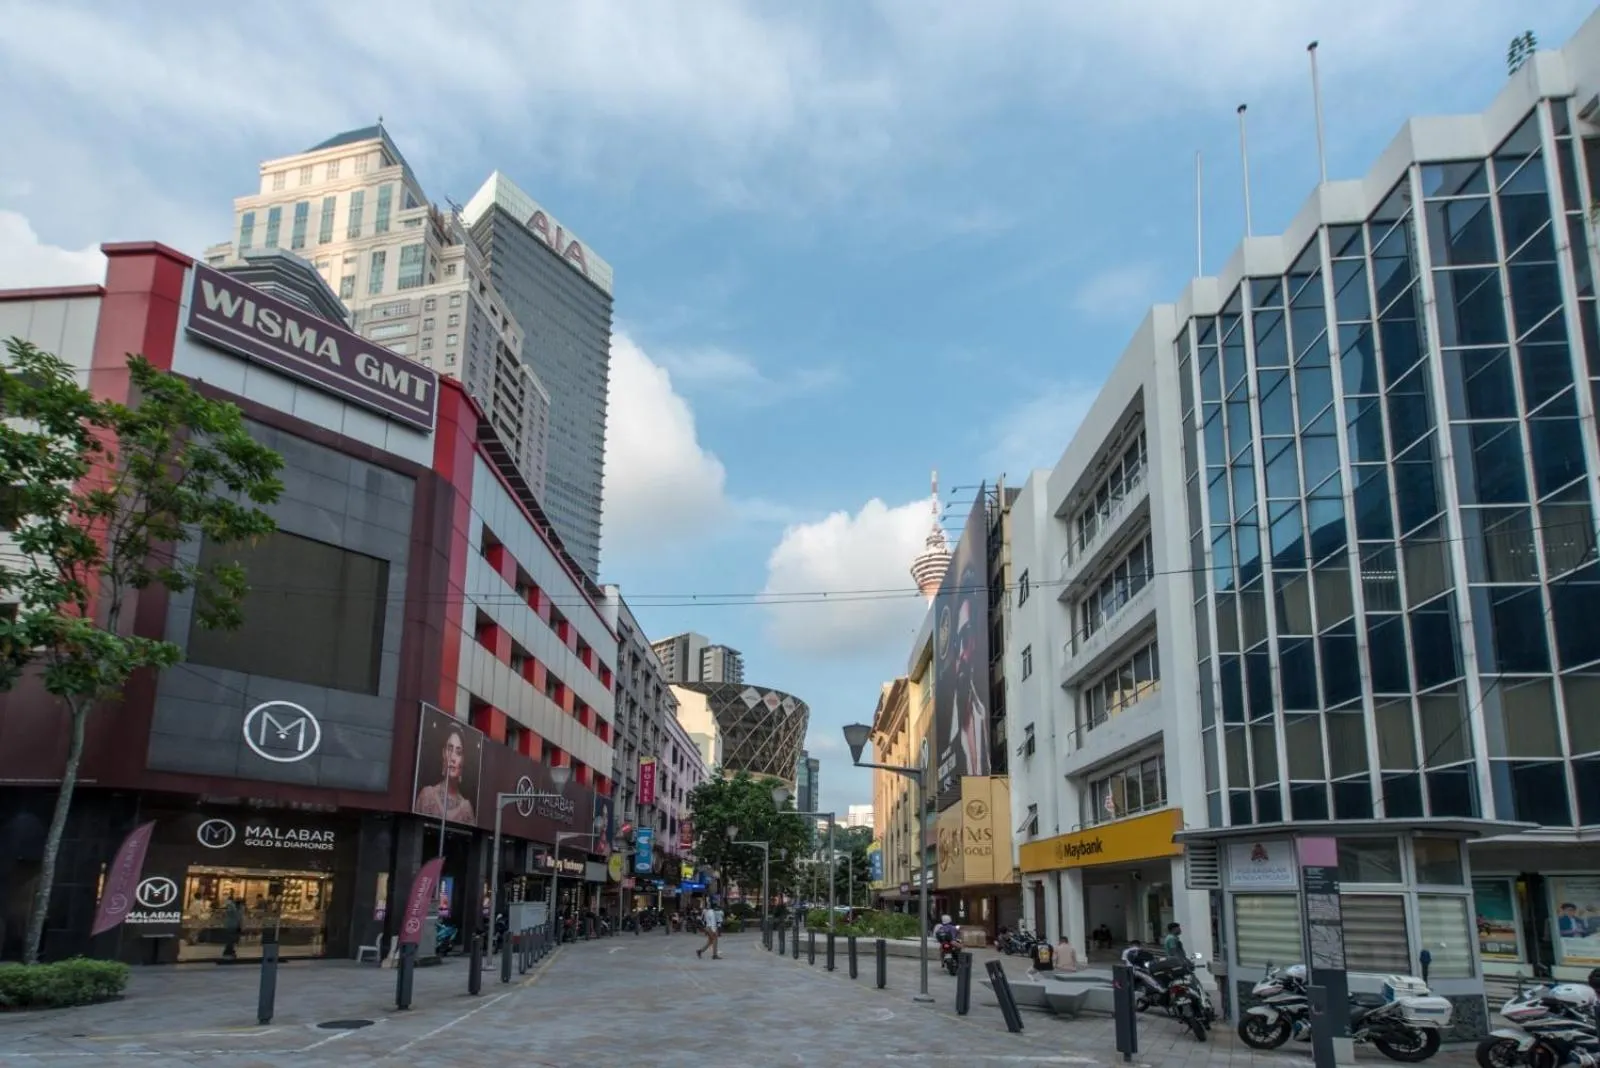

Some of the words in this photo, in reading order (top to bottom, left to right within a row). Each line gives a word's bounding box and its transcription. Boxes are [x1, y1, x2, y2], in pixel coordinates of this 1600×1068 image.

[526, 210, 589, 274] AIA
[201, 279, 342, 367] WISMA
[354, 353, 432, 402] GMT
[245, 825, 335, 842] MALABAR
[244, 839, 274, 847] GOLD
[274, 840, 282, 848] &
[283, 840, 334, 850] DIAMONDS
[964, 846, 992, 856] GOLD
[1064, 836, 1104, 861] Maybank
[125, 911, 181, 919] MALABAR
